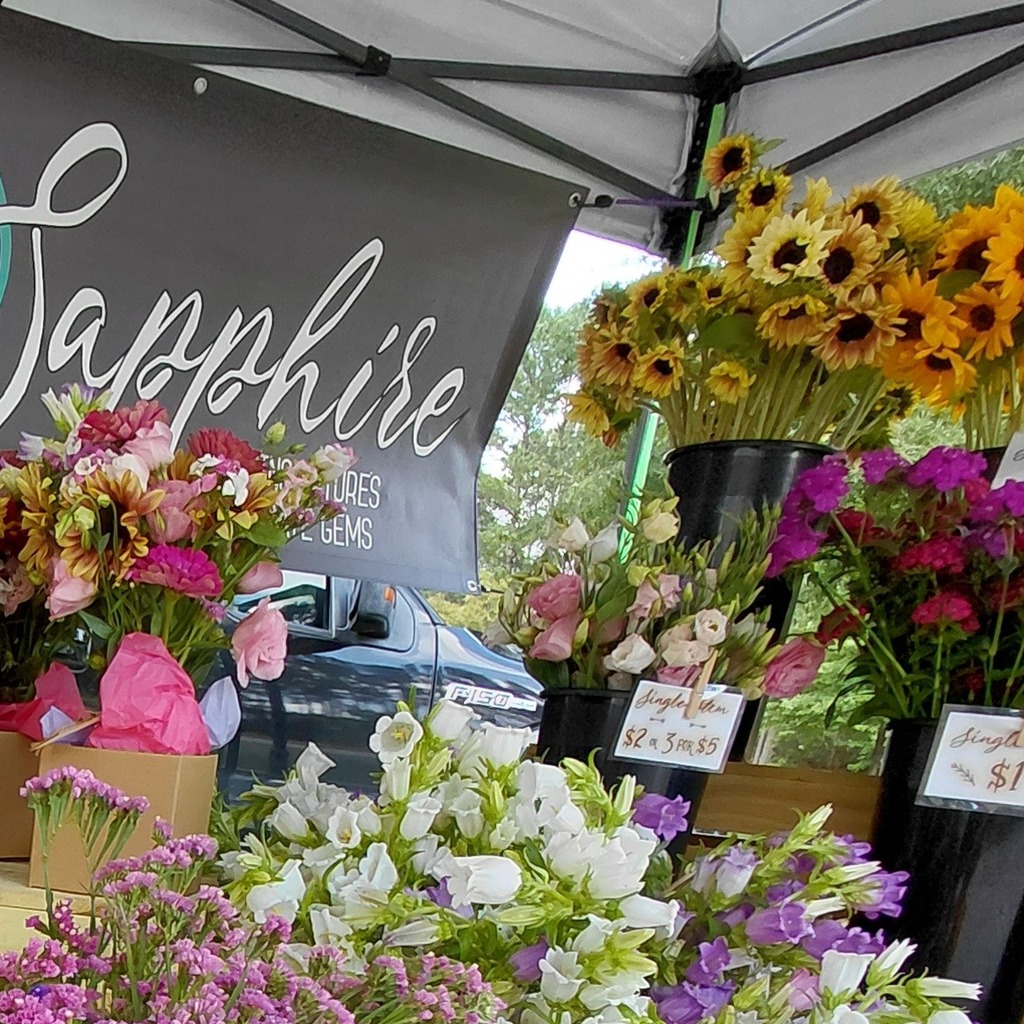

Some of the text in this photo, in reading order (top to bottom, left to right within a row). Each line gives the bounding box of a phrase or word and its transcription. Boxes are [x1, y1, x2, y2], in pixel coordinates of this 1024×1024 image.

[320, 513, 373, 550] GEMS
[622, 725, 648, 749] $2
[661, 732, 677, 754] 3
[676, 738, 695, 756] FOR
[696, 735, 720, 756] $5
[986, 757, 1024, 793] $1
